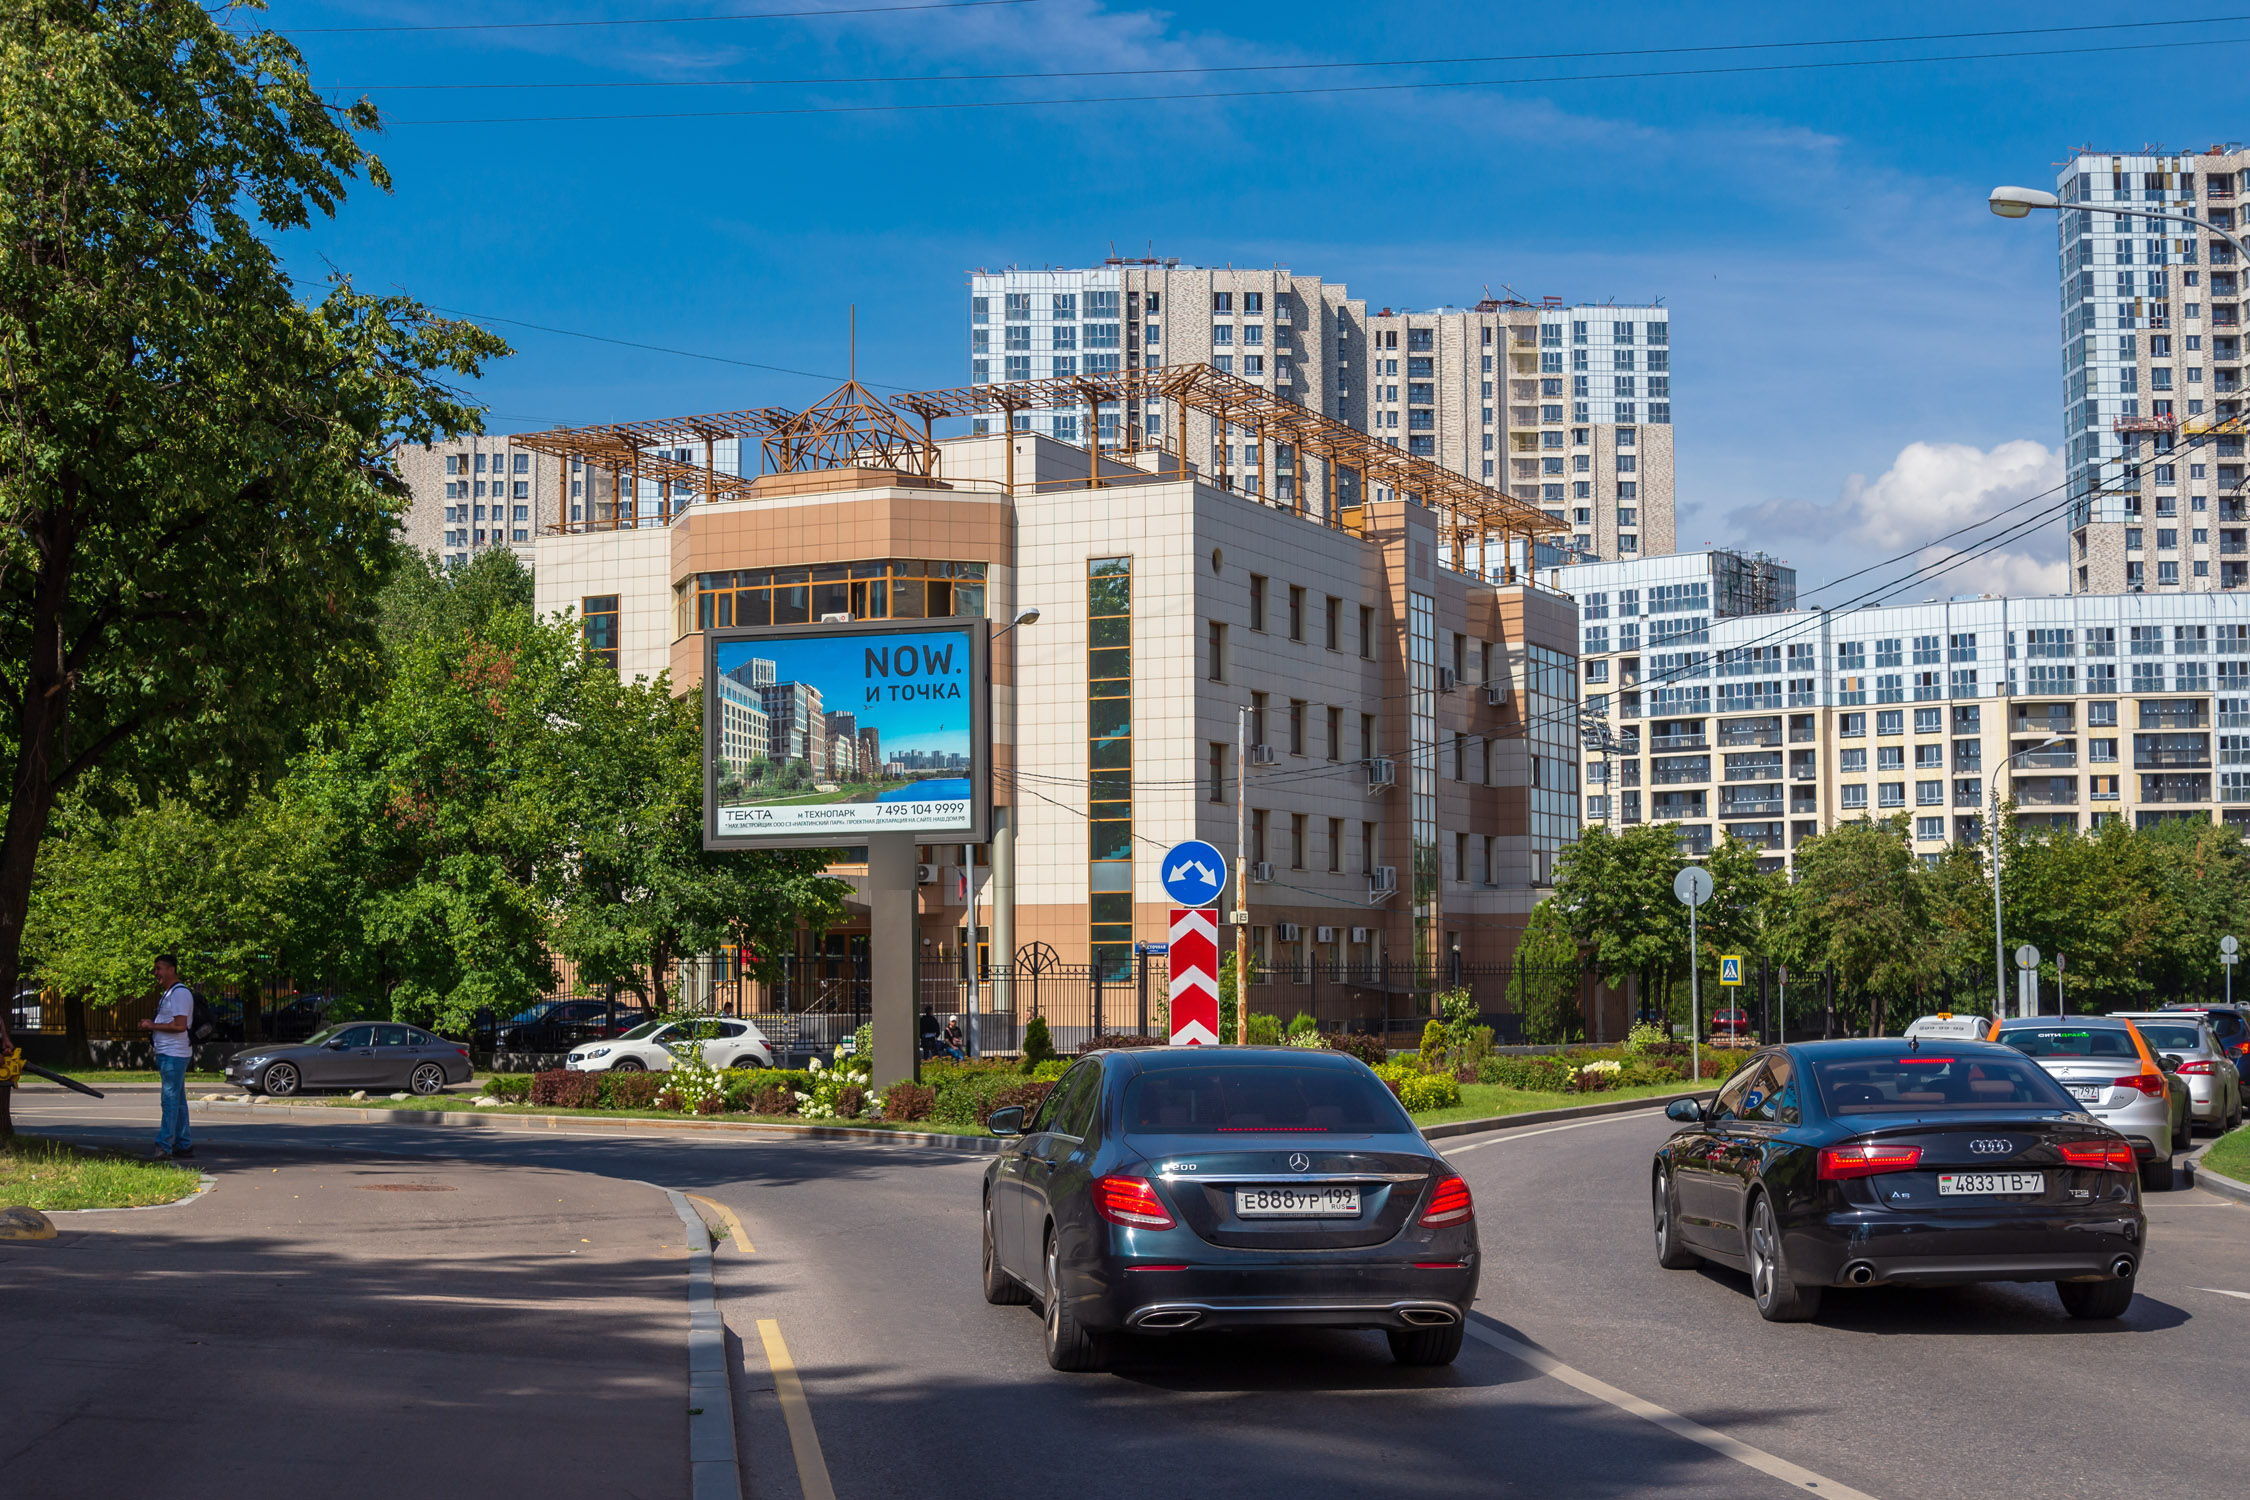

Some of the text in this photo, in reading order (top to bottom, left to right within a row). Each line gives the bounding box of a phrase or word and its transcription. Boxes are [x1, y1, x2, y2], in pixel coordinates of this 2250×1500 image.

[865, 644, 962, 678] NOW.
[866, 683, 961, 702] И ТОЧКА
[725, 809, 773, 821] ТЕКТА
[804, 809, 856, 818] ТЕХНОПАРК
[875, 802, 965, 816] 7 495 104 9999
[2079, 1087, 2095, 1095] 797
[1956, 1174, 1995, 1192] 4833
[1244, 1188, 1352, 1209] Е888УР 199
